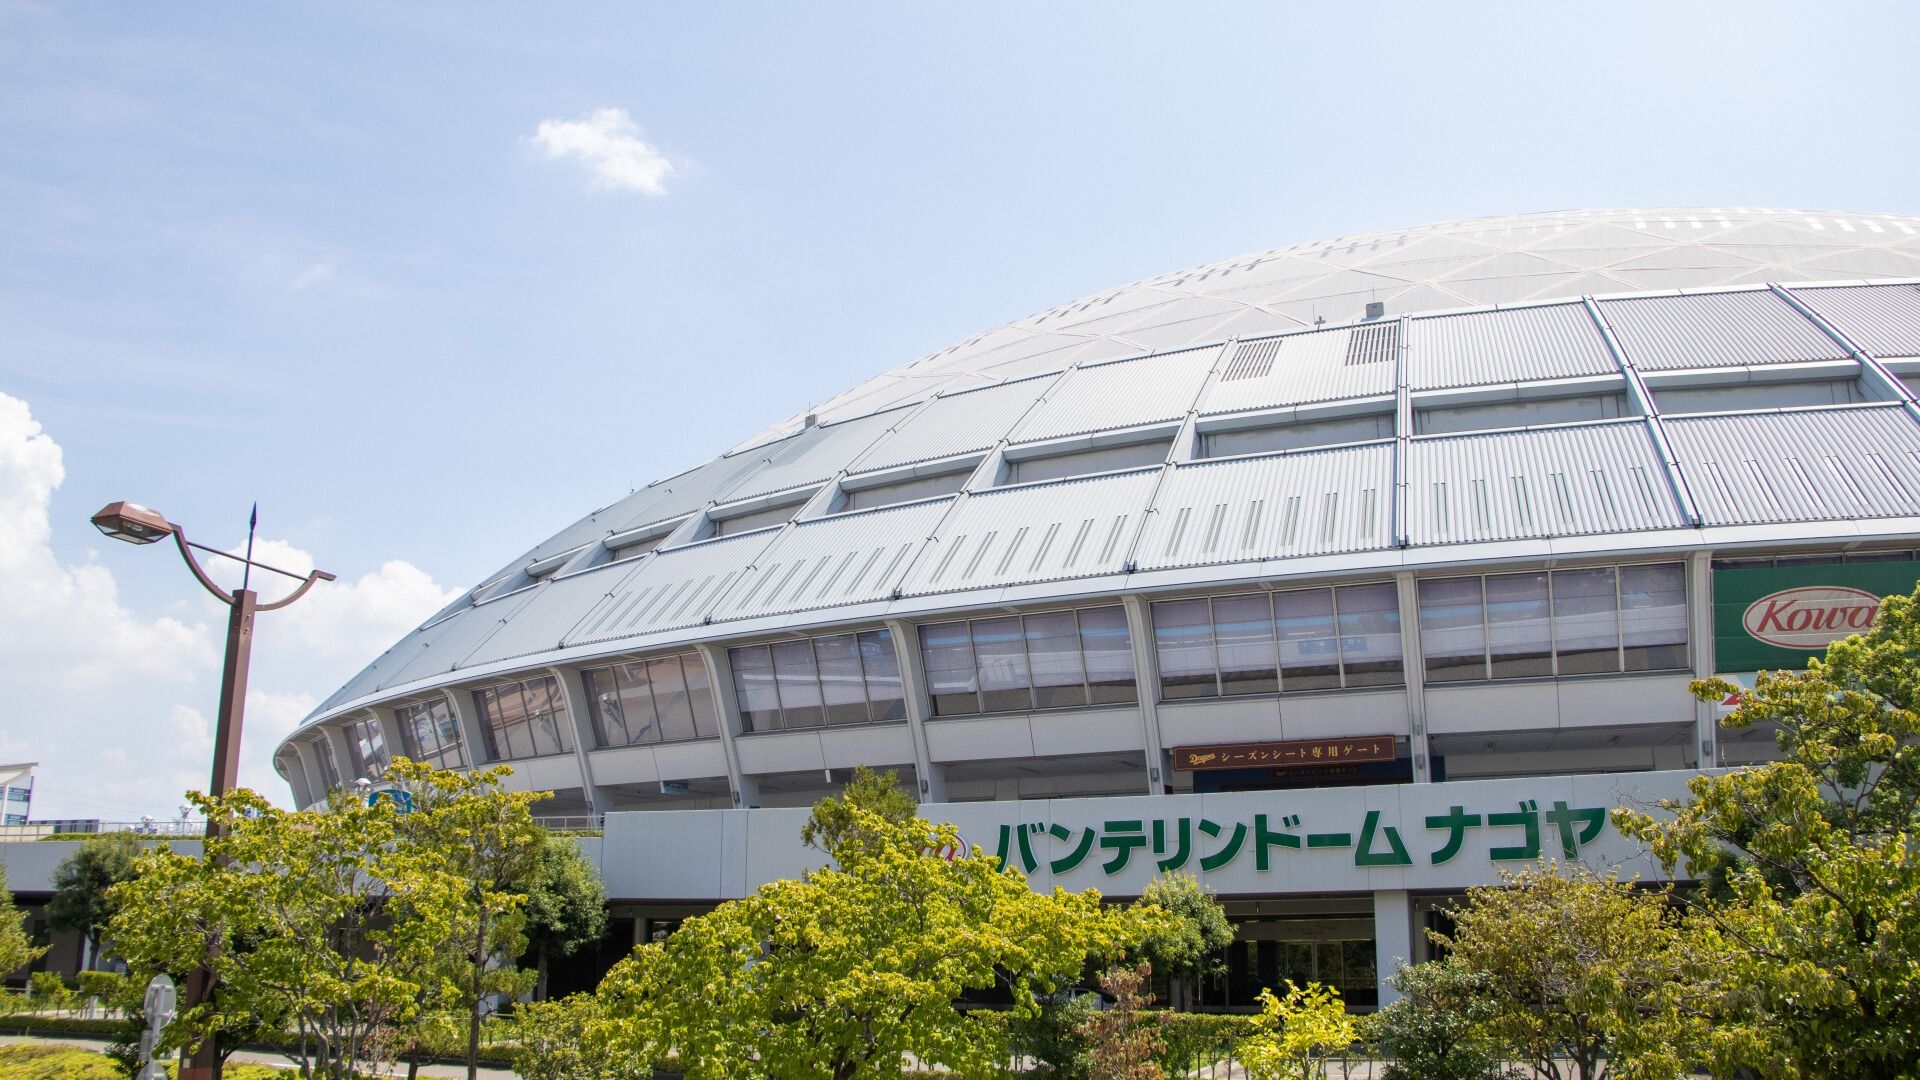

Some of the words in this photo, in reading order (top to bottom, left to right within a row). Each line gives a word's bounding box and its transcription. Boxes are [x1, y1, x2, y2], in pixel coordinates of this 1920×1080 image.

[1757, 600, 1877, 632] Kowa
[1189, 753, 1216, 765] Dragons
[1221, 744, 1380, 762] シーズンシート専用ゲート
[997, 810, 1413, 875] バンテリンドーム
[1426, 800, 1607, 864] ナゴヤ
